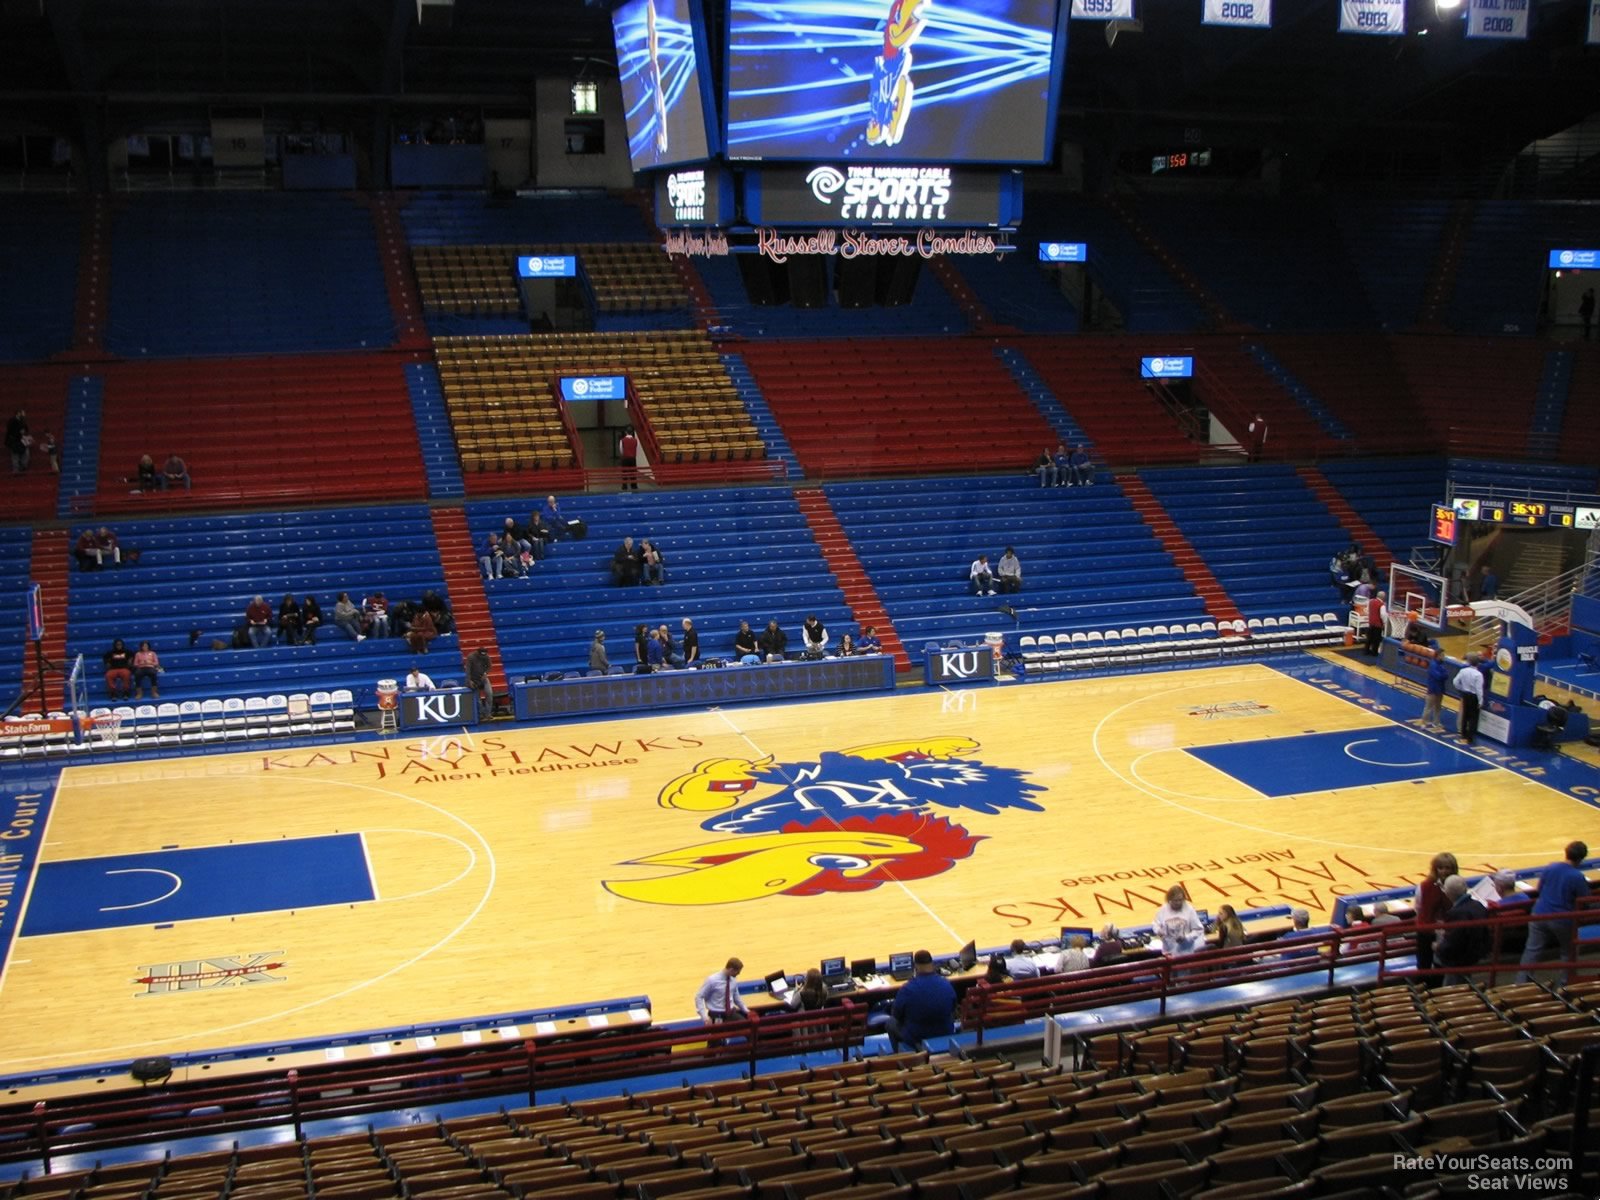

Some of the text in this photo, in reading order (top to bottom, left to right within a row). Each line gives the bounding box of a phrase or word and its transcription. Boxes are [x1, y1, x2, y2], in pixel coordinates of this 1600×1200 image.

[1083, 0, 1113, 12] 1993
[1222, 3, 1253, 19] 2002
[1358, 12, 1388, 26] 2003
[1483, 17, 1513, 32] 2008
[848, 167, 950, 179] TIME WARNER CABLE
[843, 178, 951, 205] SPORTS
[841, 204, 946, 219] CHANNEL
[754, 227, 996, 263] Russell Stover Candies
[543, 258, 564, 266] Capitol
[589, 379, 612, 387] Capitol
[1493, 510, 1502, 520] 0
[1511, 502, 1544, 516] 36:47
[1562, 515, 1571, 526] 0
[940, 651, 979, 678] KU
[1308, 678, 1392, 711] James
[416, 693, 462, 722] KU
[4, 723, 51, 734] State Farm
[262, 737, 506, 771] KANSAS
[376, 734, 704, 780] JAYHAWKS
[414, 757, 639, 785] Allen Fieldhouse
[793, 778, 917, 811] KU
[0, 793, 43, 840] Court
[1061, 848, 1295, 887] Allen Fieldhouse
[992, 853, 1372, 928] JAYHAWKS
